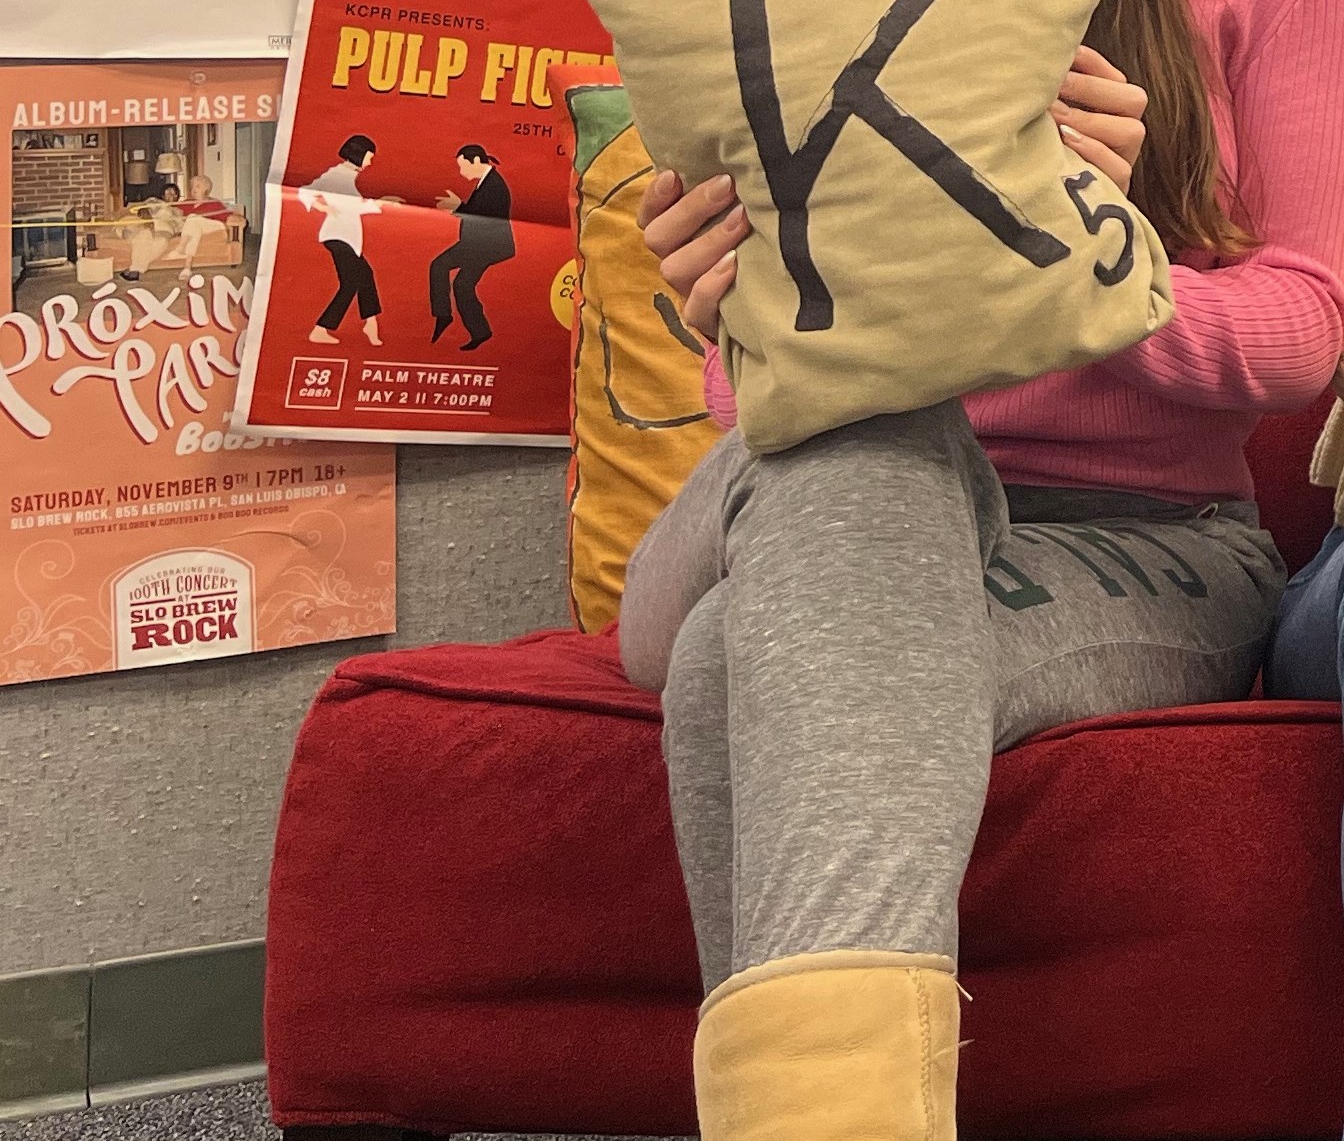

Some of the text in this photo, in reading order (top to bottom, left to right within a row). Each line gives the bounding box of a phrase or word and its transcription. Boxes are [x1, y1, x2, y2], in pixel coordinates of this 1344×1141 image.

[345, 3, 490, 32] KCPR PRESENTS:
[332, 26, 469, 98] PULP
[13, 95, 246, 128] ALBUM-RELEASE
[513, 123, 553, 138] 25TH
[1065, 170, 1136, 287] 5
[304, 368, 331, 386] $8
[361, 369, 496, 388] PALM THEATRE
[299, 387, 331, 399] cash
[357, 389, 493, 407] MAY 2 7:00PM
[11, 487, 111, 514] SATURDAY,
[117, 476, 217, 503] NOVEMBER
[266, 466, 304, 487] 7PM
[314, 464, 346, 482] 18+
[129, 575, 238, 601] 100TH CONCERT
[131, 598, 238, 624] SLO BREW
[131, 613, 238, 651] ROCK
